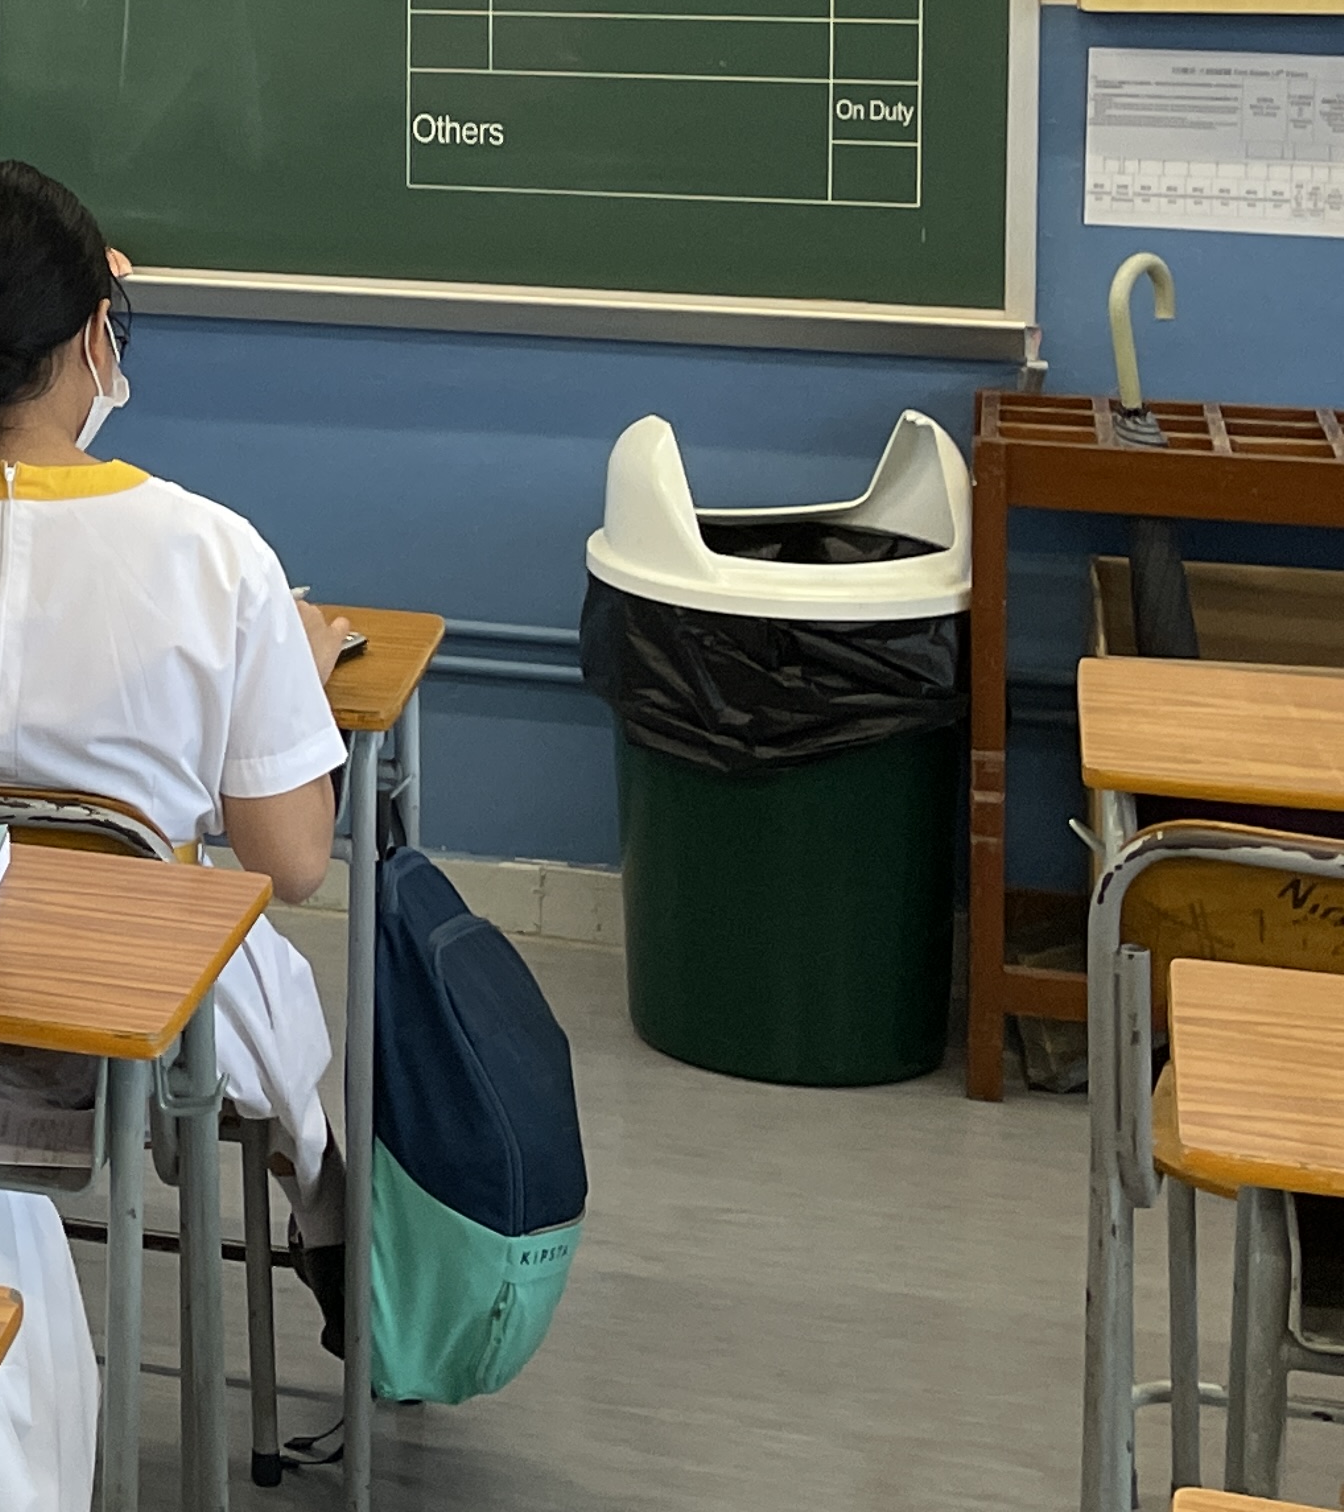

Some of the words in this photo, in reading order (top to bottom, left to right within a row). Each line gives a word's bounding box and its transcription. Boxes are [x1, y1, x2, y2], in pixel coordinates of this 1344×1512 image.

[835, 98, 865, 122] On
[869, 100, 914, 128] Duty
[412, 112, 504, 147] Others
